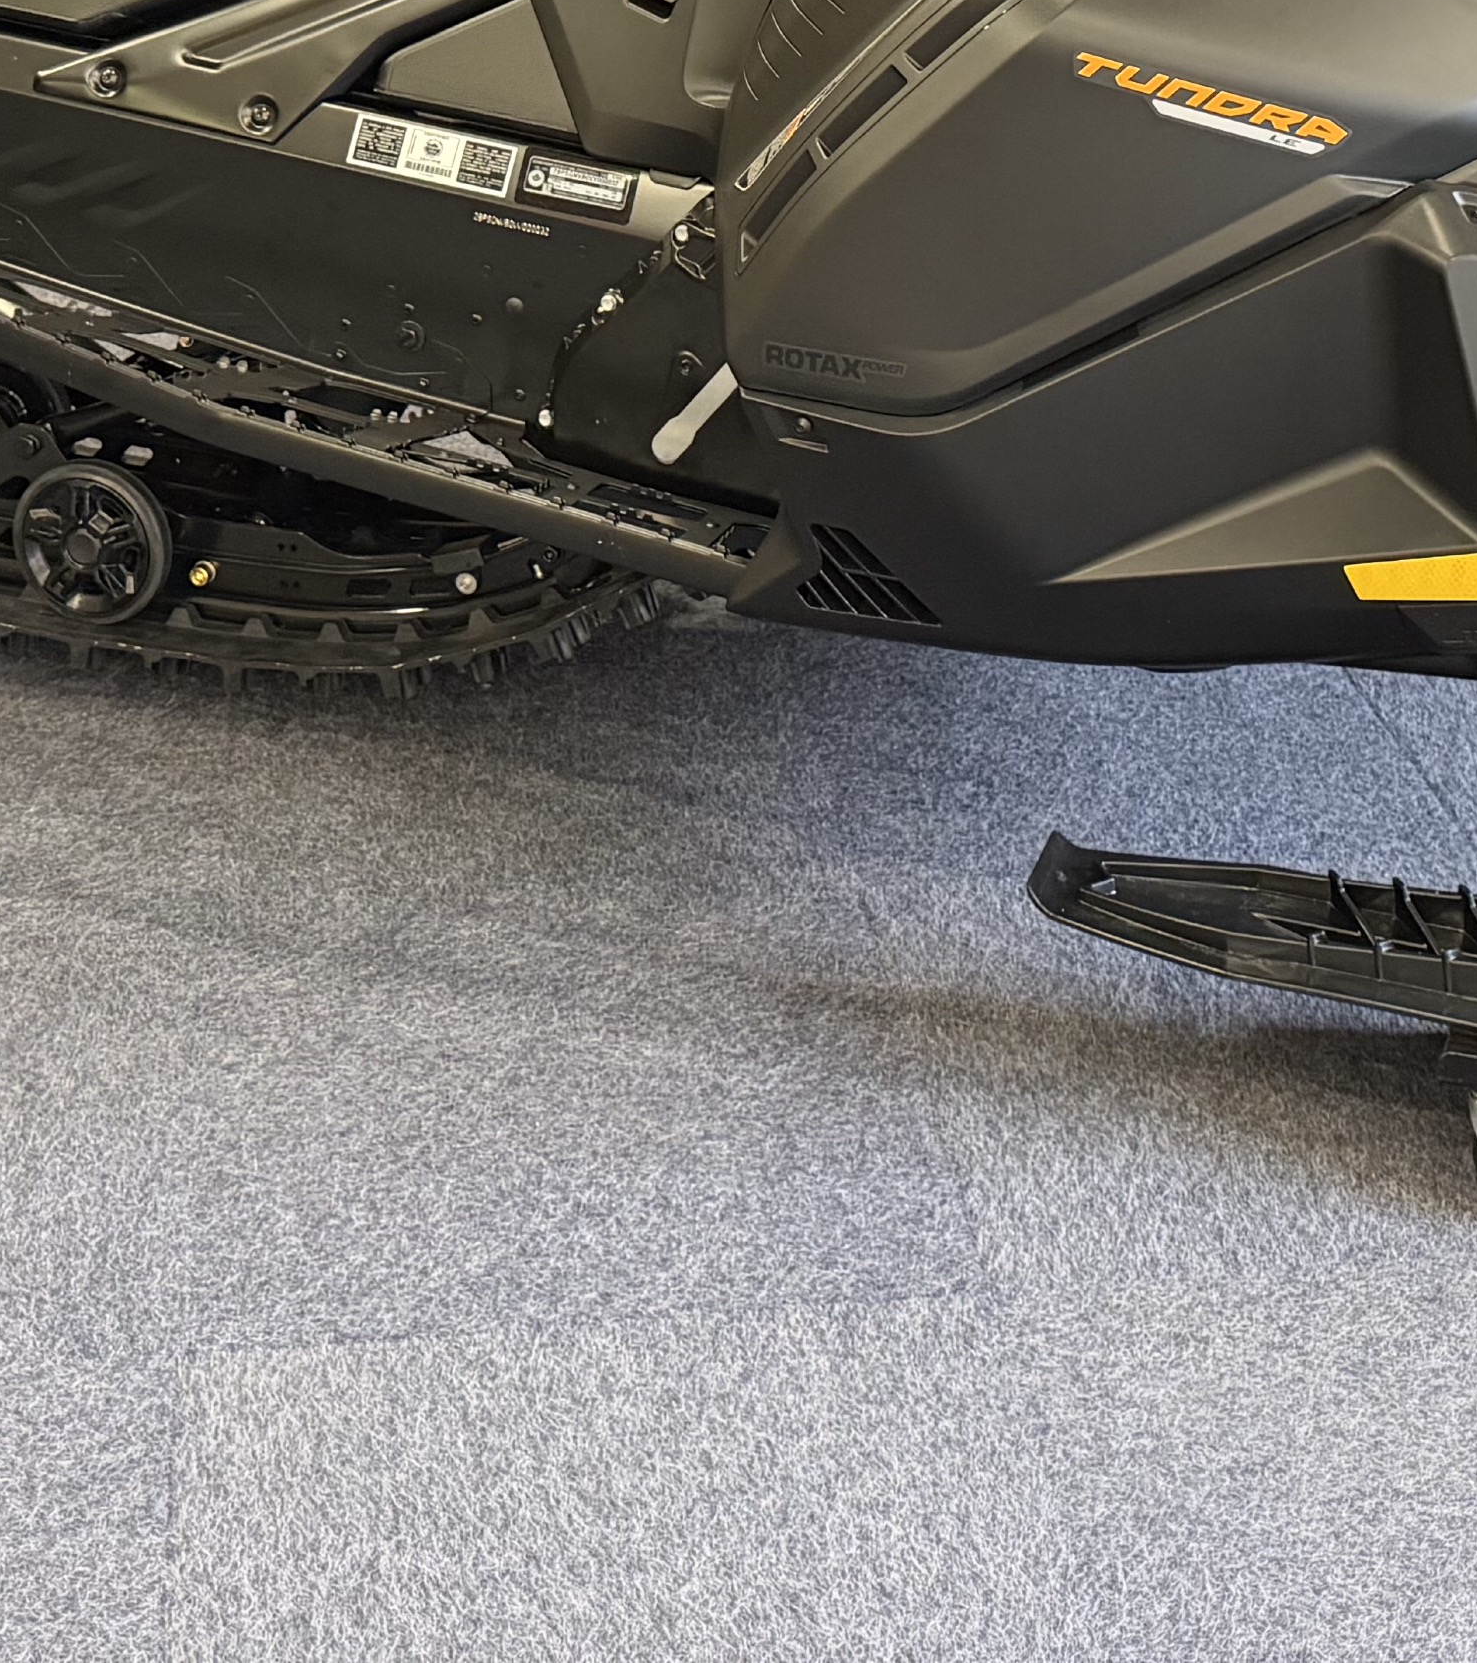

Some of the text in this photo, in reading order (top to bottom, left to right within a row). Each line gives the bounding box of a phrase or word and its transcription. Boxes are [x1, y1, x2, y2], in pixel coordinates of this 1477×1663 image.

[1076, 51, 1349, 145] TUNDRA
[1267, 134, 1301, 148] LE
[765, 343, 905, 380] ROTAX POWER
